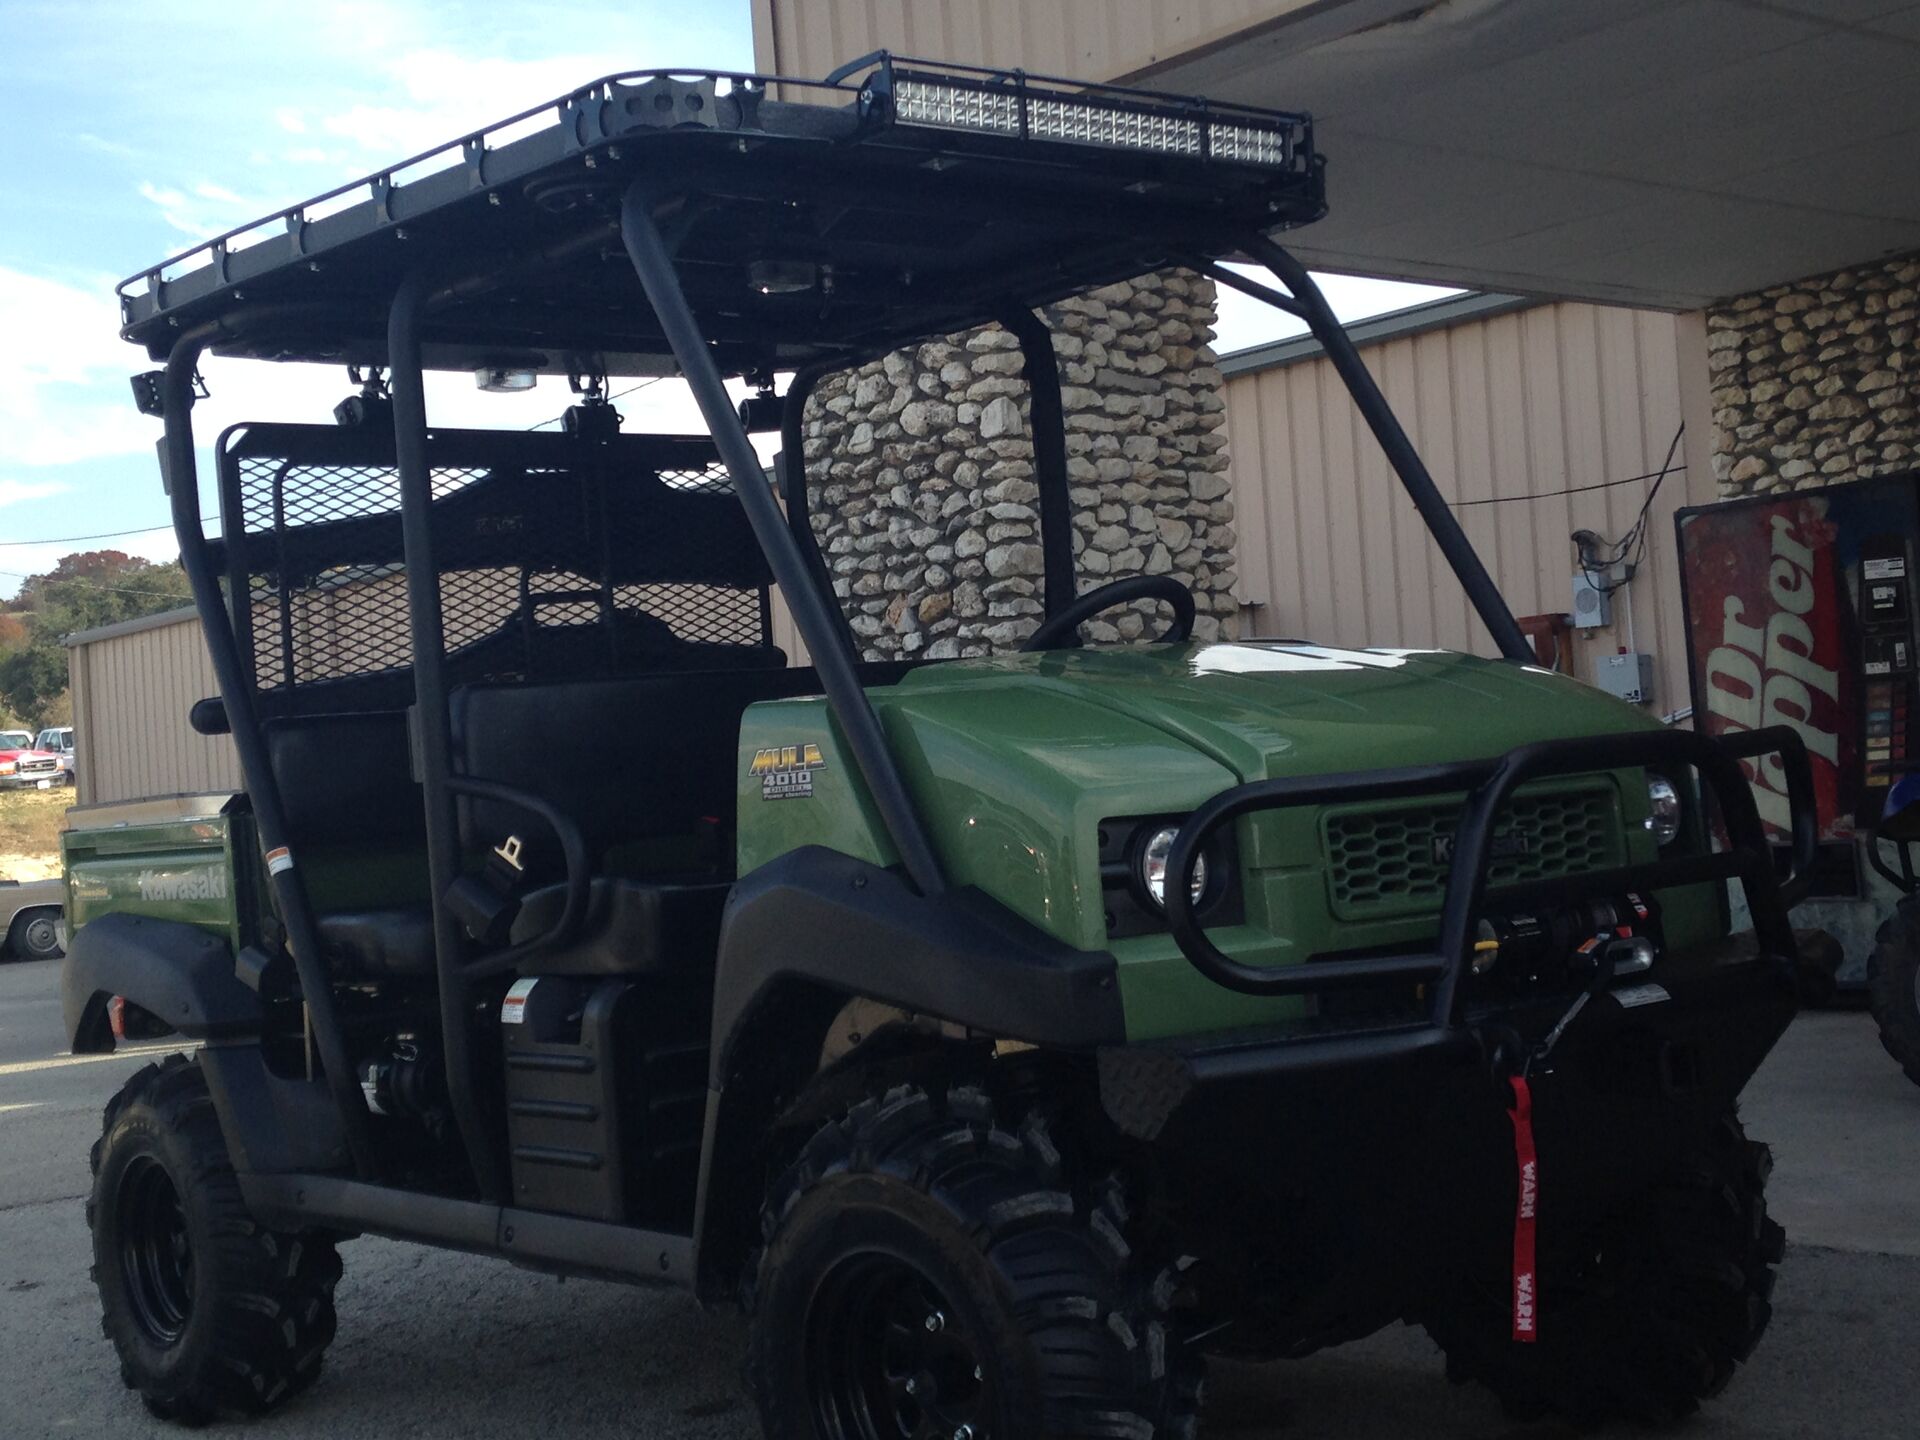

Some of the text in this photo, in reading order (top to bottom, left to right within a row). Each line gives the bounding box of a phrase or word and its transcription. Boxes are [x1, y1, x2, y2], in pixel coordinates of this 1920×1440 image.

[1706, 594, 1764, 730] Dr
[748, 743, 827, 777] MULE
[763, 771, 811, 787] 4010
[139, 866, 227, 901] Kawasaki
[1520, 1161, 1536, 1219] WARN
[1517, 1272, 1533, 1331] WARN
